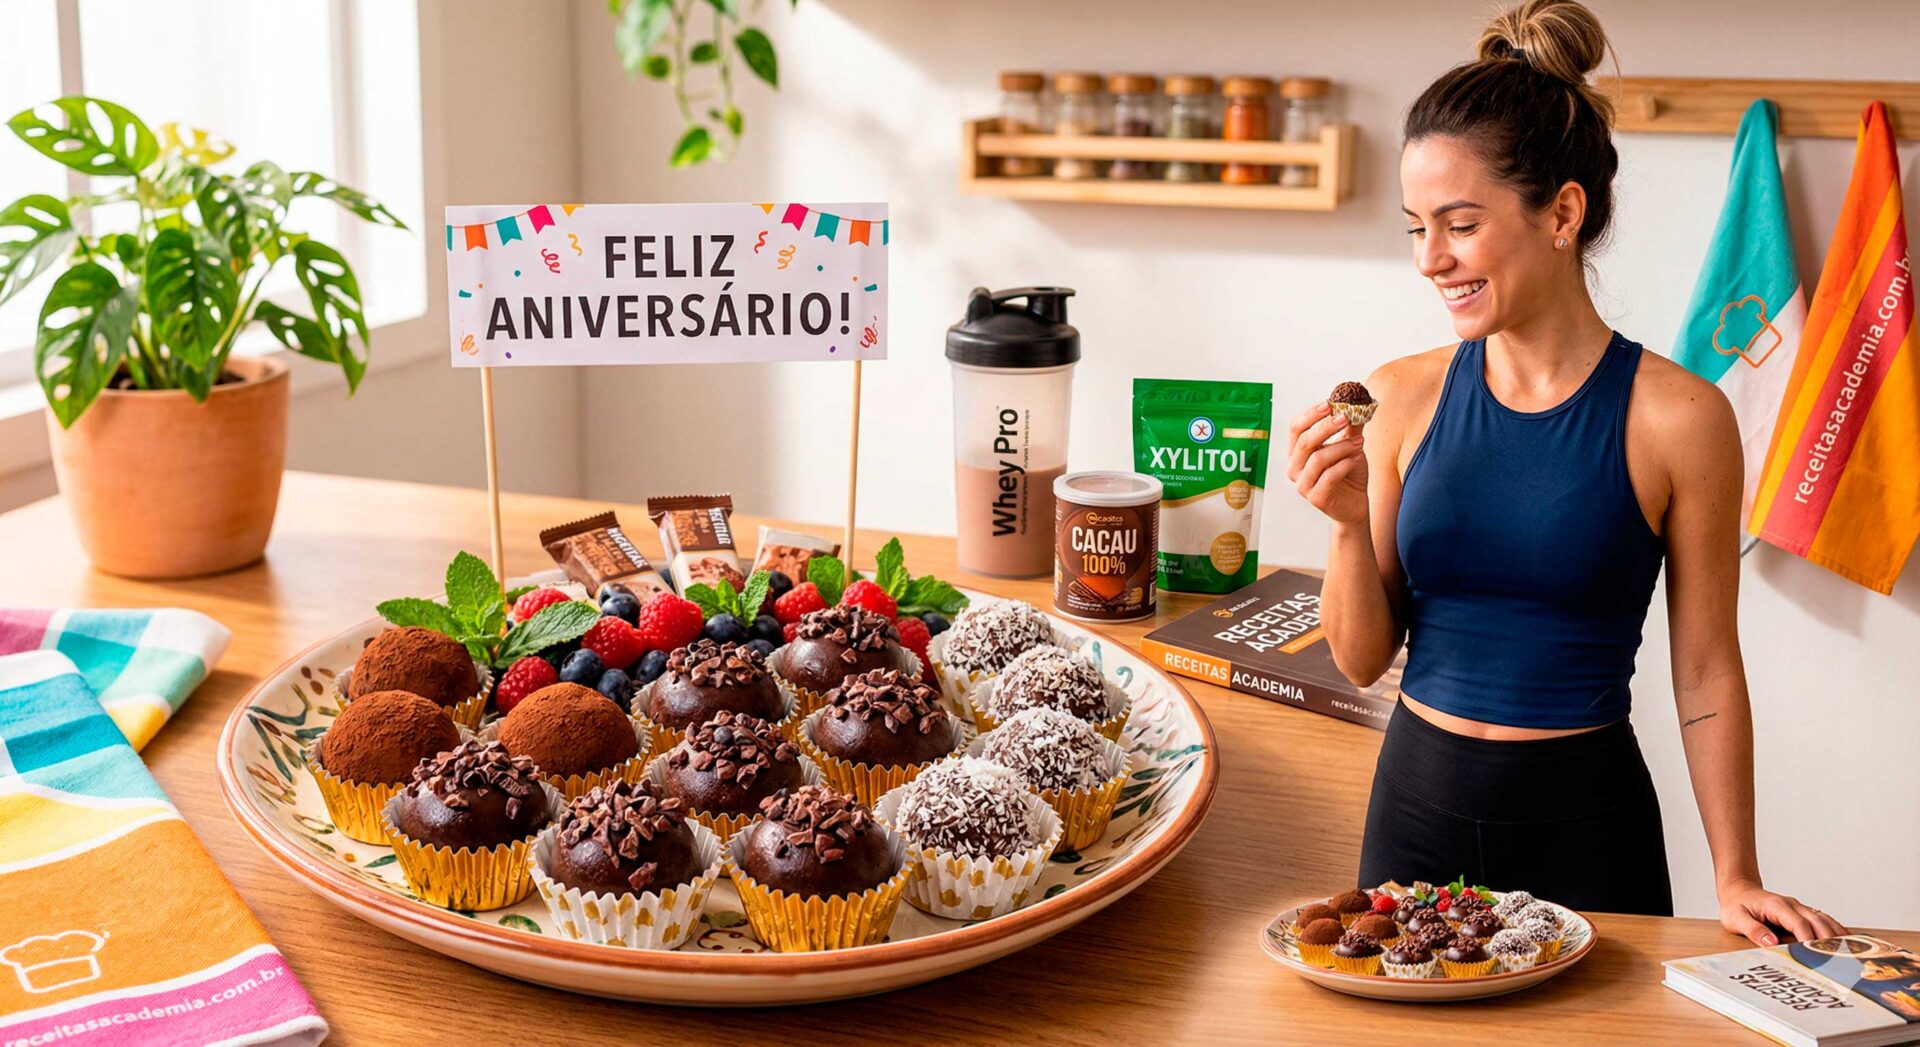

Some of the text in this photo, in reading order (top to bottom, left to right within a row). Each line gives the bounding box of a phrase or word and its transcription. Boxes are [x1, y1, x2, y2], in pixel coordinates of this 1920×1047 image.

[604, 234, 736, 279] FELIZ
[485, 281, 851, 341] ANIVERSÁRIO!
[1794, 247, 1912, 505] receitasacademia.com.br
[992, 408, 1026, 537] Whey Pro
[1149, 446, 1252, 473] XYLITOL
[1071, 525, 1138, 555] CACAU
[1081, 553, 1127, 575] 100%
[1213, 592, 1321, 644] RECEITAS
[1164, 652, 1306, 702] RECEITAS ACADEMIA
[4, 966, 285, 1047] receitasacademia.com.br
[1728, 973, 1820, 1011] RECEITAS
[1747, 963, 1855, 1009] ACADEMIA
